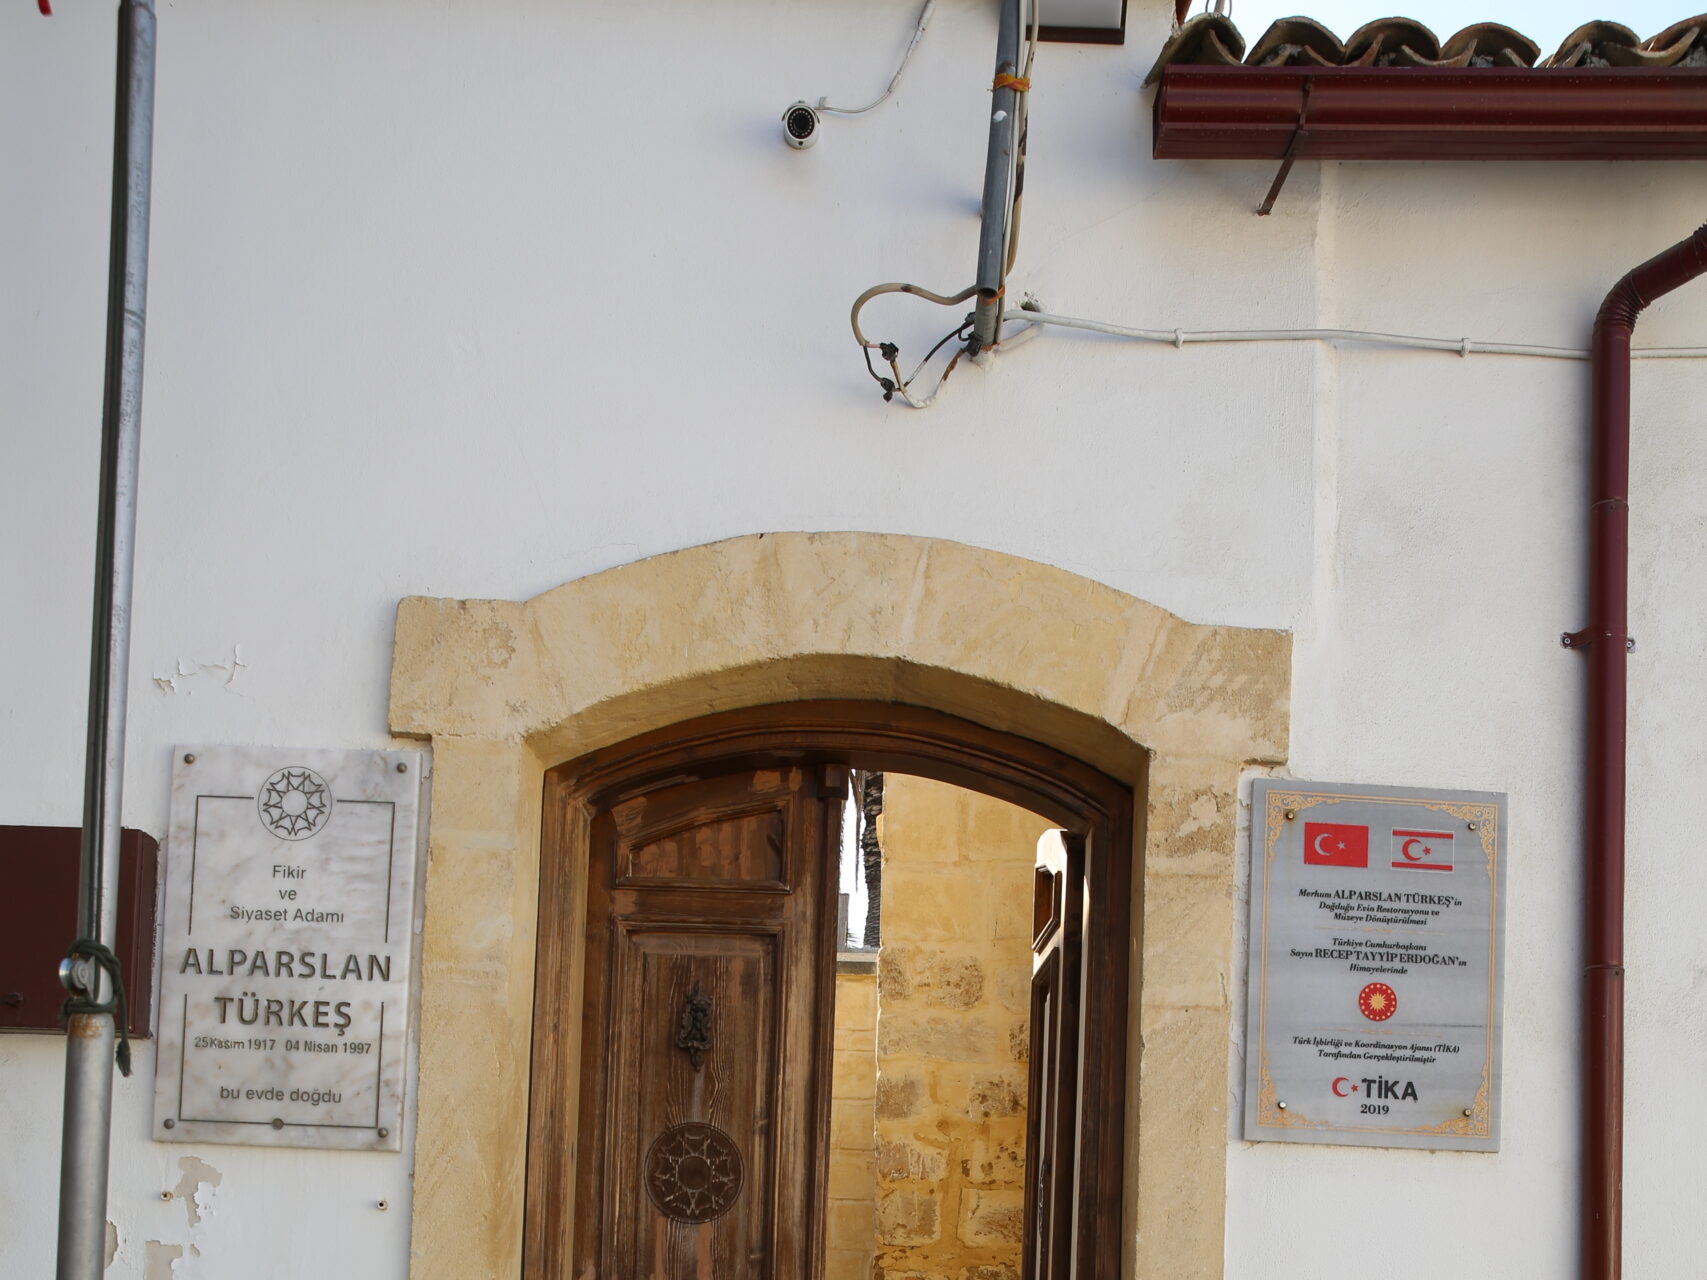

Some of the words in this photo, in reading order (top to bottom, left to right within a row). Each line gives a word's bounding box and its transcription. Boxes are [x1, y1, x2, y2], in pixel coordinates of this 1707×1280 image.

[272, 865, 307, 879] Fikir
[279, 889, 297, 900] ve
[1299, 889, 1332, 899] Merhum
[1333, 889, 1401, 903] ALPARSLAN
[230, 906, 288, 923] Siyaset
[293, 908, 344, 923] Adamı
[1319, 902, 1355, 913] Doğduğu
[1357, 903, 1375, 912] Evin
[1376, 905, 1430, 919] Restorasyonu
[1333, 913, 1364, 923] Müzeye
[1365, 915, 1428, 926] Dönüştürülmesi
[1332, 938, 1364, 949] Türkiye
[1365, 940, 1427, 952] Cumhurbaşkanı
[1289, 949, 1314, 959] Sayın
[1315, 948, 1353, 960] RECEP
[1354, 949, 1398, 963] TAYYİP
[179, 948, 391, 981] ALPARSLAN
[1350, 963, 1408, 975] Himayelerinde
[214, 992, 352, 1036] TÜRKEŞ
[248, 1039, 276, 1050] 1917
[285, 1040, 300, 1051] 04
[304, 1040, 338, 1053] Nisan
[342, 1042, 372, 1054] 1997
[1292, 1036, 1311, 1045] Türk
[1354, 1040, 1408, 1052] Koordinasyon
[1409, 1043, 1433, 1053] Ajansı
[1433, 1044, 1460, 1053] (TİKA)
[1318, 1050, 1362, 1060] Tarafından
[1363, 1052, 1436, 1064] Gerçekleştirilmiştir
[220, 1086, 240, 1099] bu
[246, 1087, 285, 1101] evde
[289, 1088, 342, 1105] doğdu
[1361, 1075, 1418, 1103] TİKA
[1360, 1104, 1389, 1115] 2019
